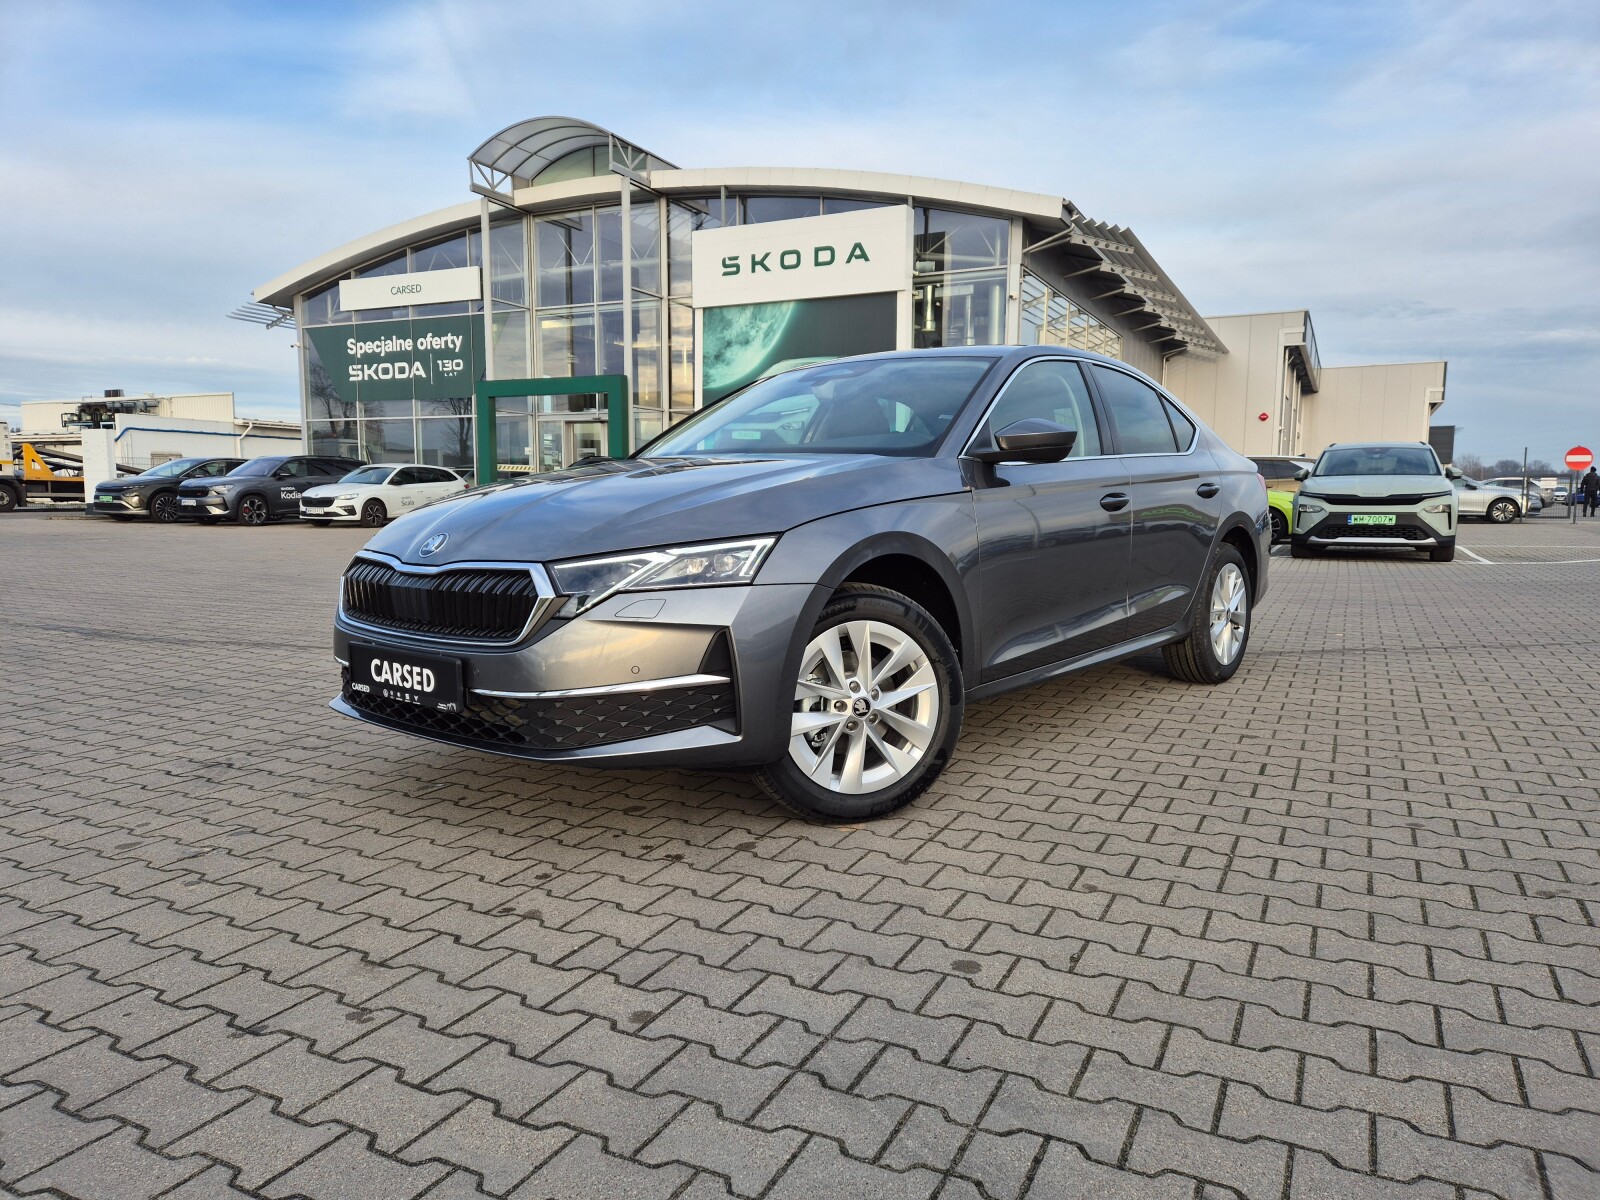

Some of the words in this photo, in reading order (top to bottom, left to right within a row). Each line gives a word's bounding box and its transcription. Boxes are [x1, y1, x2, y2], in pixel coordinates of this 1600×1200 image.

[390, 284, 422, 295] CARSED
[346, 335, 414, 359] Specjalne
[416, 332, 463, 353] oferty
[437, 359, 464, 371] 130
[280, 490, 303, 500] Kodia
[400, 499, 415, 507] Scala
[370, 658, 435, 693] CARSED
[351, 682, 371, 693] CARSED
